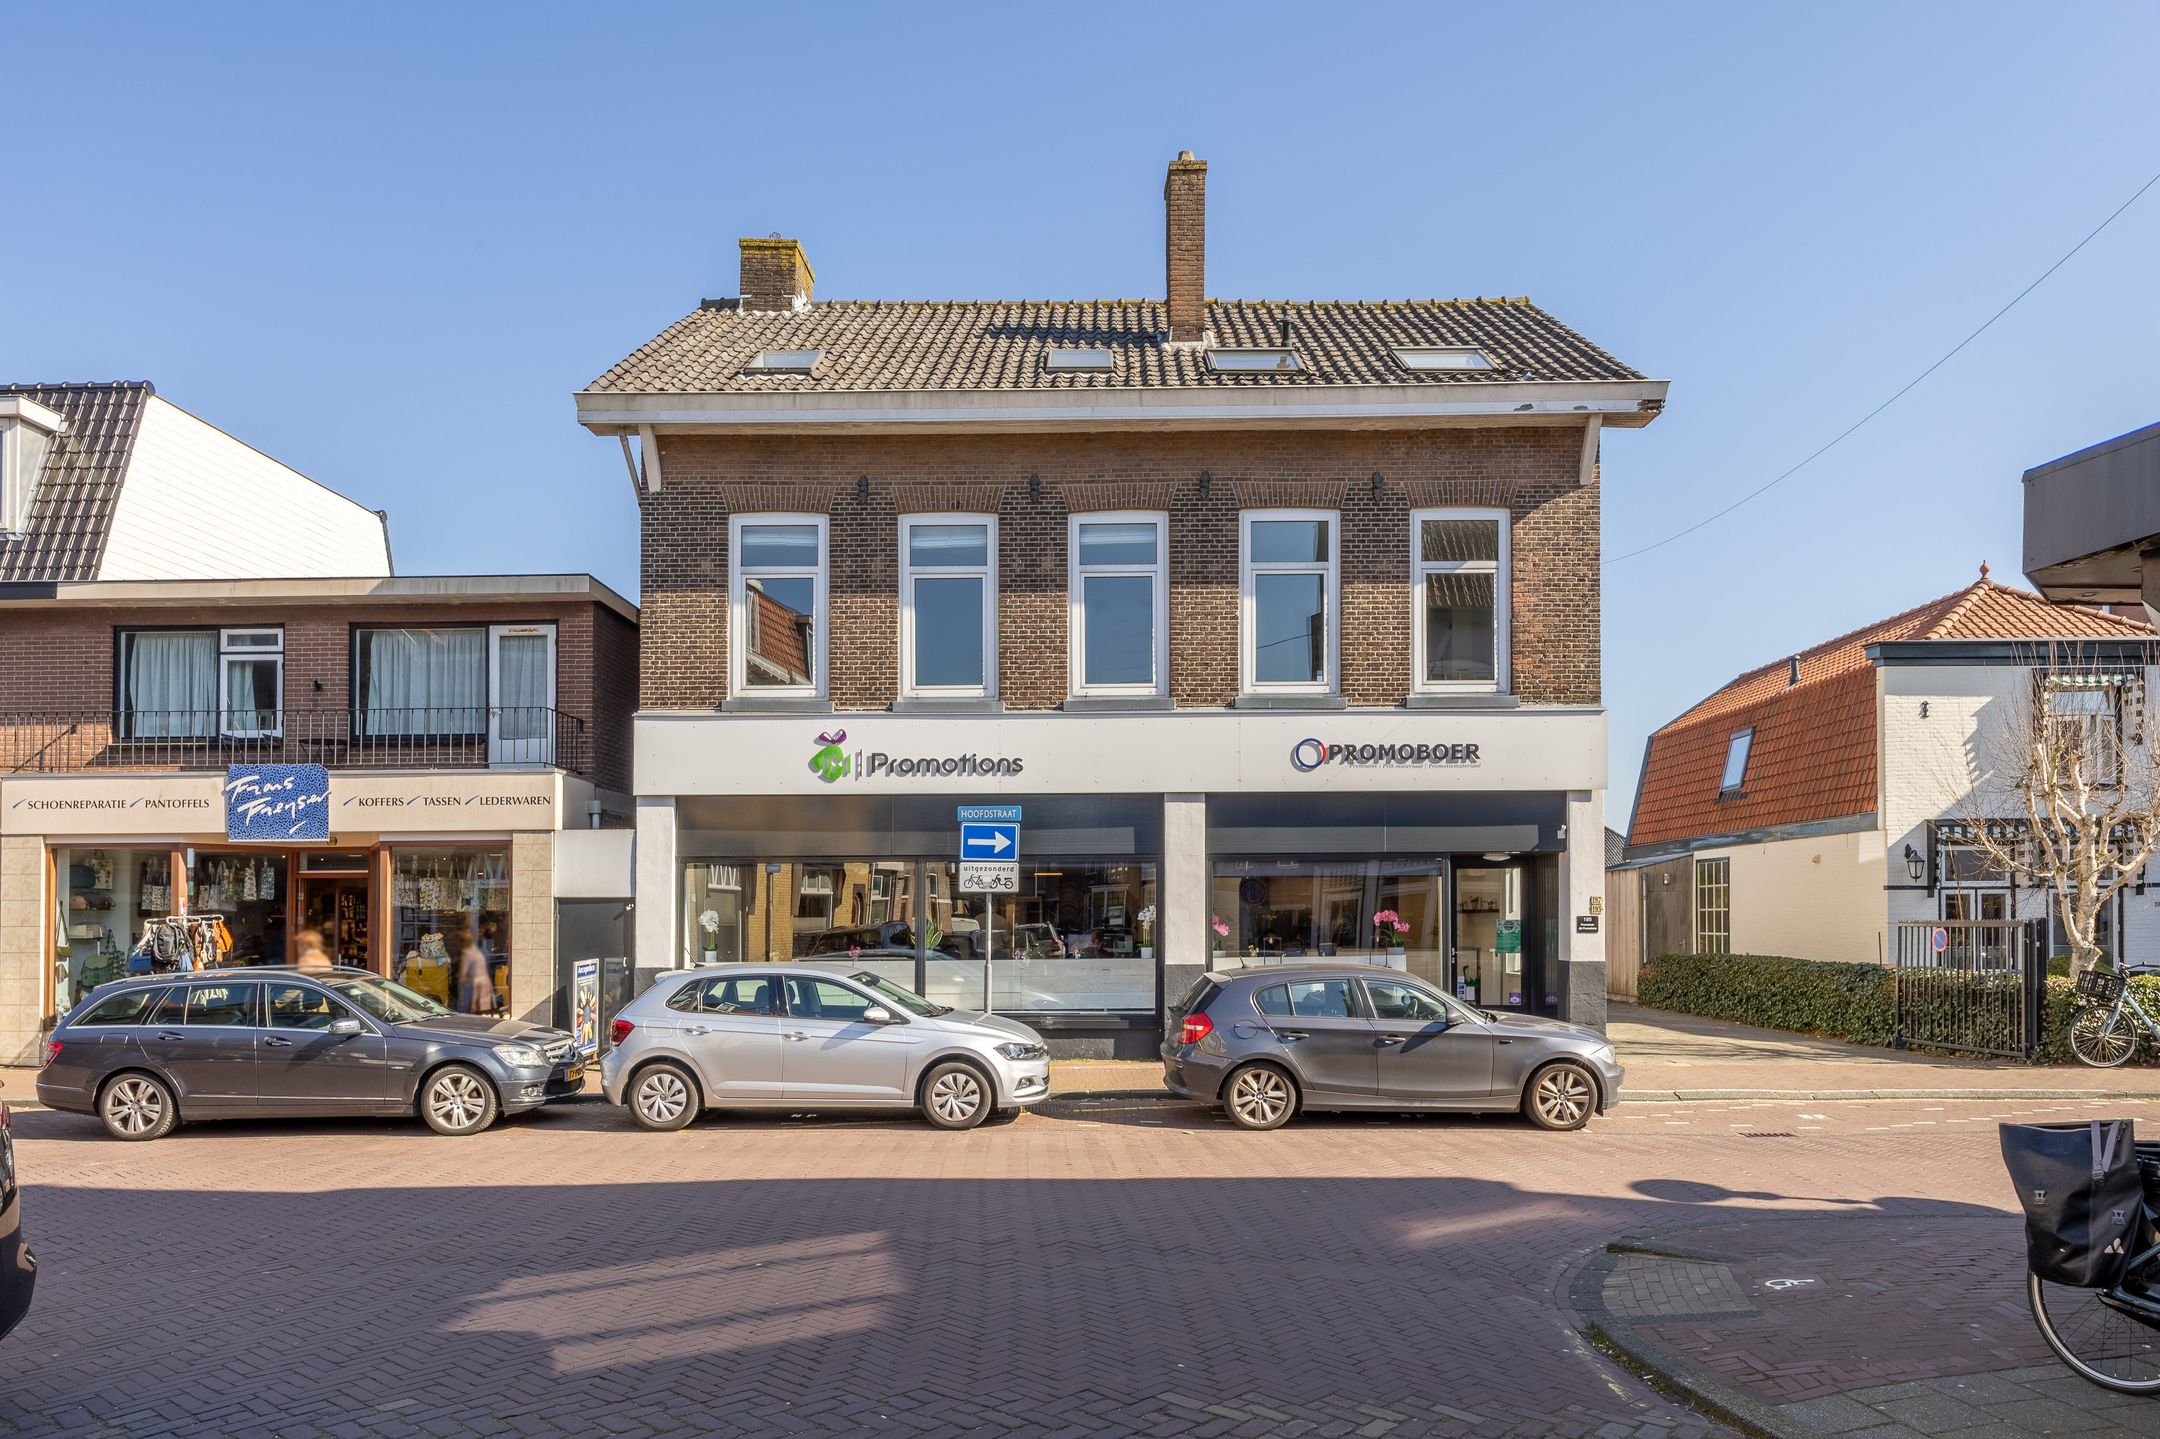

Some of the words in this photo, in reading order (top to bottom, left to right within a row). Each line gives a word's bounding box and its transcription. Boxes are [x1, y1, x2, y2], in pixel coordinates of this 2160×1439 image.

[1329, 744, 1481, 761] PROMOBOER
[871, 752, 1024, 774] Promotions
[225, 775, 295, 803] Frans
[27, 800, 127, 810] SCHOENREPARATIE
[145, 799, 210, 809] PANTOFFELS
[358, 797, 404, 807] KOFFERS
[423, 797, 461, 806] TASSEN
[479, 796, 551, 806] LEDERWAREN
[961, 809, 1017, 818] HOOFDSTRAAT
